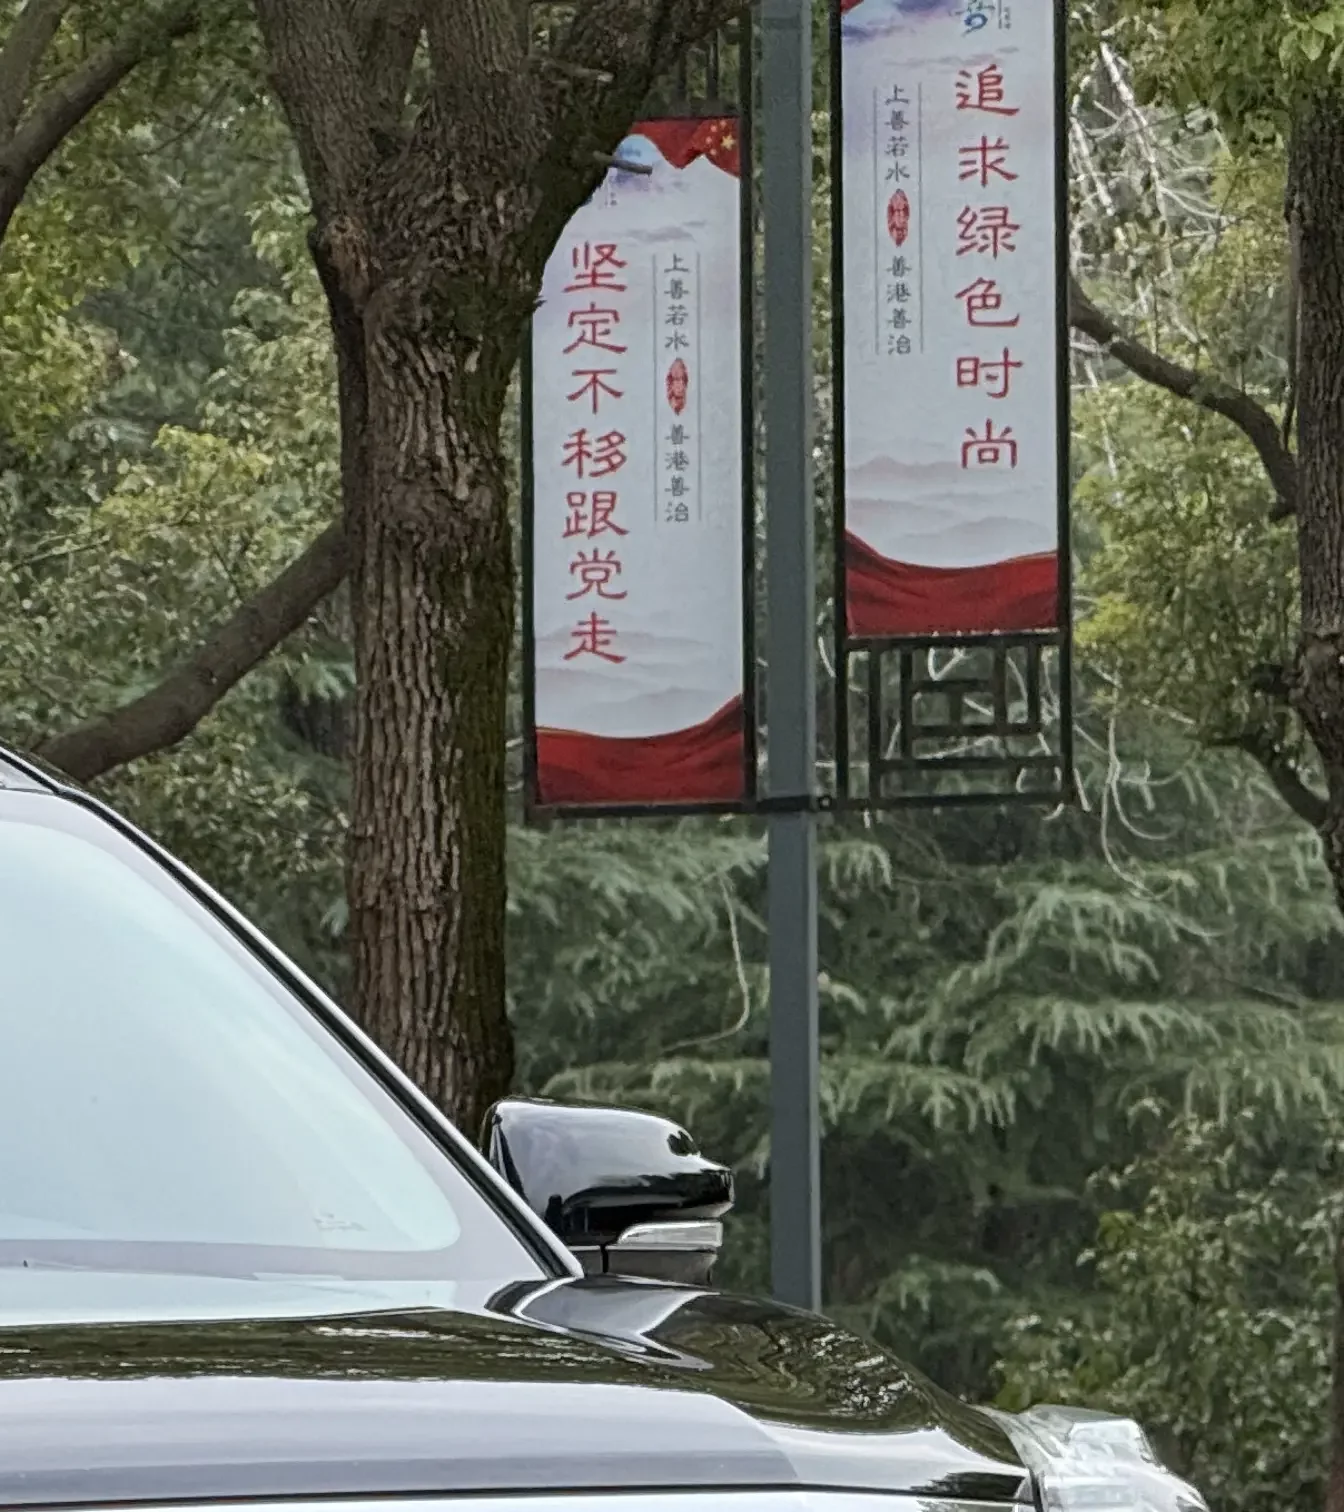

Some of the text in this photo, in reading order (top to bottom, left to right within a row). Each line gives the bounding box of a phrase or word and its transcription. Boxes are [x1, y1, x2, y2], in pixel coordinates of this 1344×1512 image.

[885, 84, 910, 182] 上善若水
[664, 253, 690, 351] 上善若水
[887, 255, 912, 355] 善港善治
[955, 64, 1023, 468] 追求绿色时尚
[562, 241, 630, 664] 坚定不移跟党走
[664, 424, 690, 522] 善港善治
